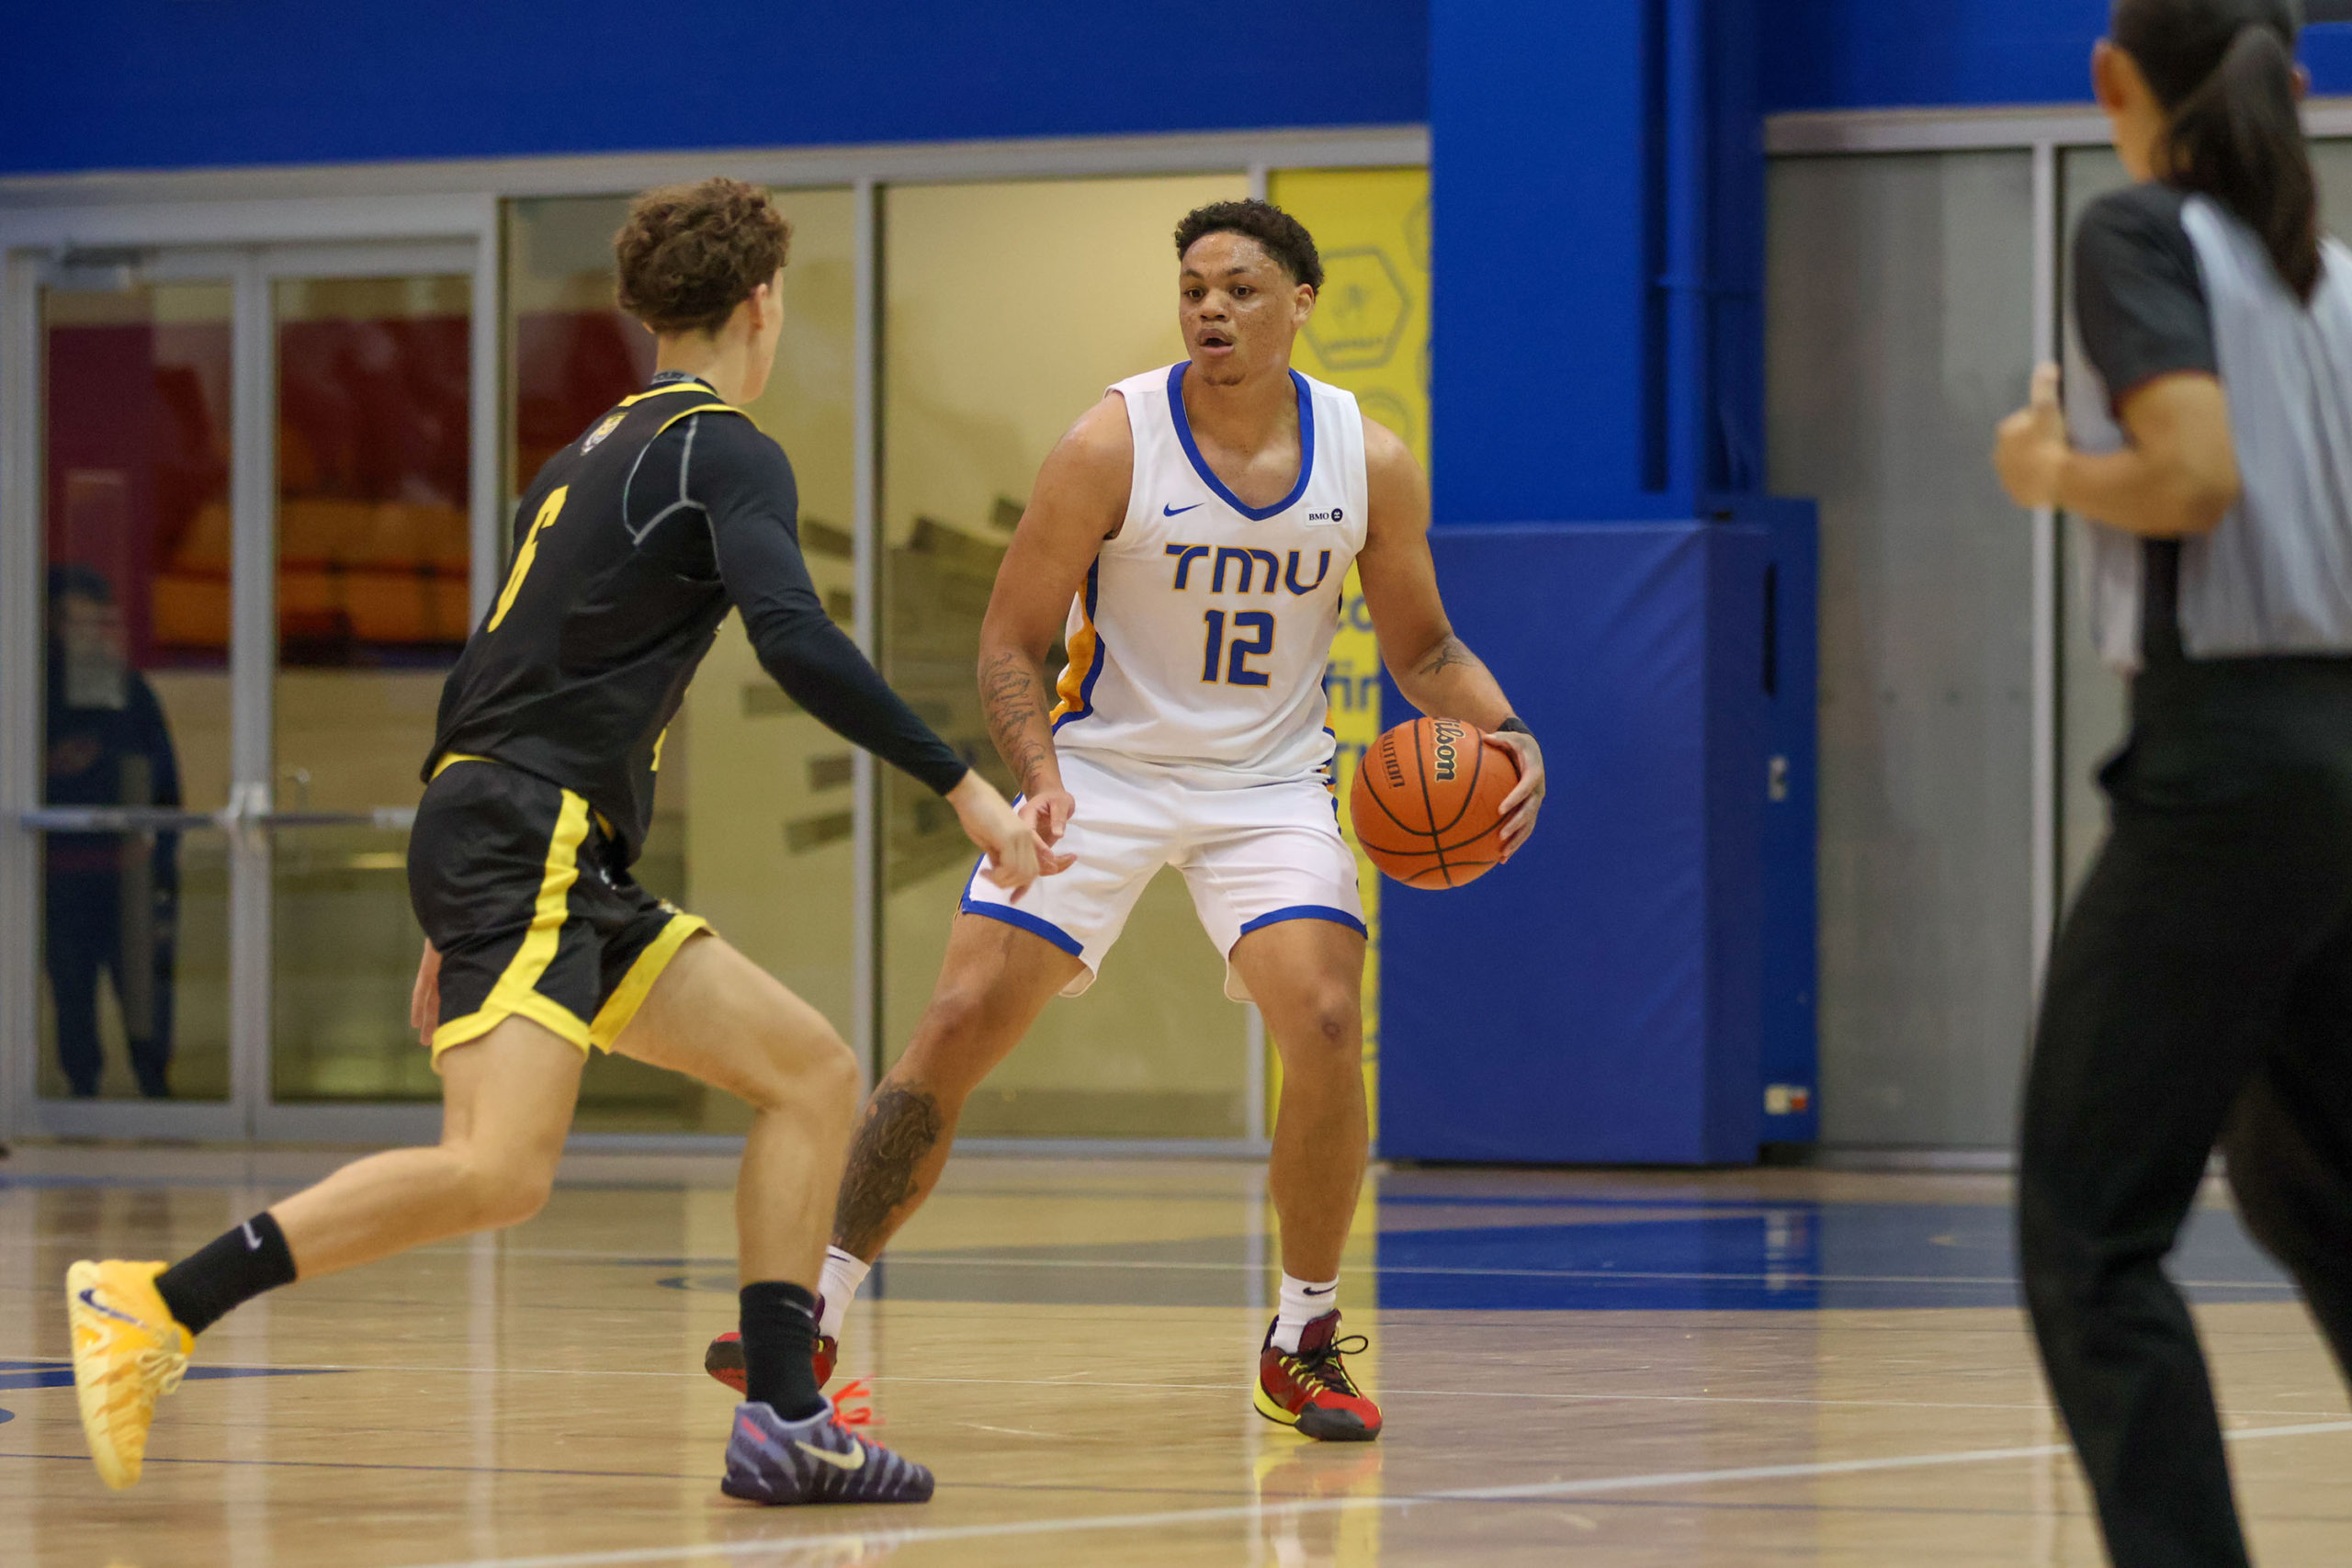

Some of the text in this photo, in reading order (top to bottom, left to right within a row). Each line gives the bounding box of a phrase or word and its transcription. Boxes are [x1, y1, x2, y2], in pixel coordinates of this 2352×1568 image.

[1308, 512, 1329, 521] BMO
[487, 484, 570, 633] 6
[1163, 541, 1332, 597] TMU
[1200, 609, 1275, 688] 12
